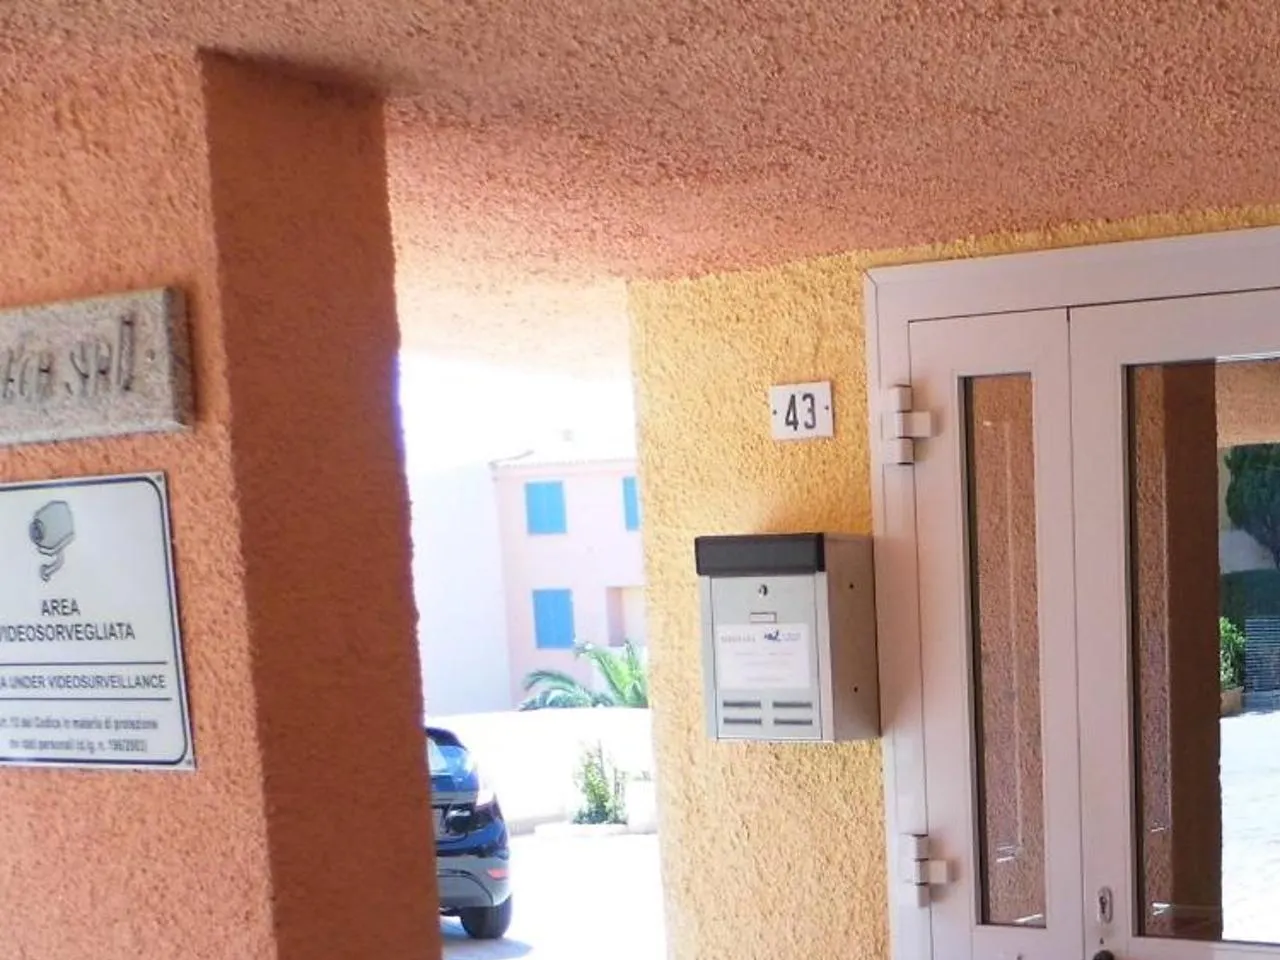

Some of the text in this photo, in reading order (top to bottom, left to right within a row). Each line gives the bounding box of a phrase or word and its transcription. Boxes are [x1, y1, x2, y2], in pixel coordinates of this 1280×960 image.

[785, 393, 817, 431] 43
[41, 598, 81, 617] AREA
[48, 674, 167, 690] VIDEOSURVEILLANCE
